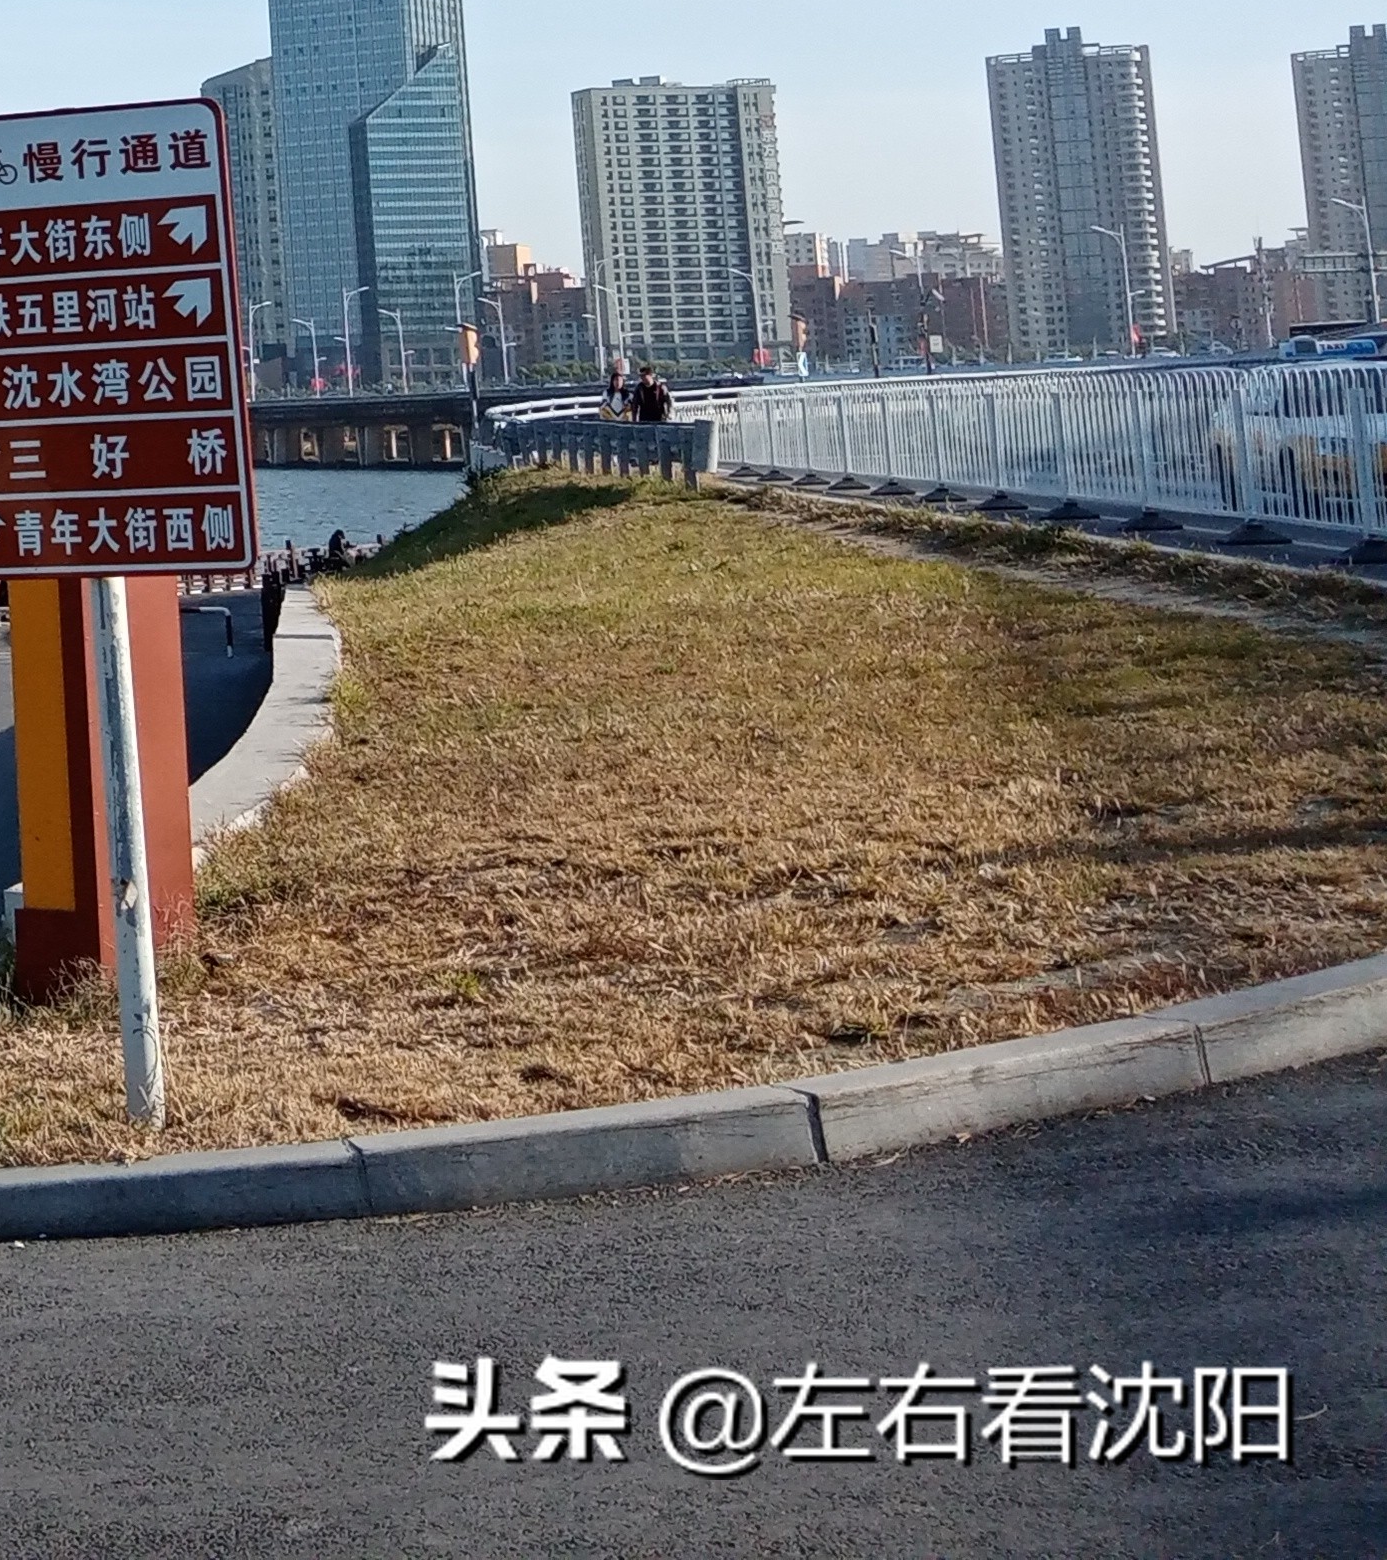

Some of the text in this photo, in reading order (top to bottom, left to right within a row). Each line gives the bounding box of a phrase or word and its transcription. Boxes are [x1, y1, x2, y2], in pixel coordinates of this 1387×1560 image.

[23, 129, 211, 184] 慢行通道
[1319, 343, 1345, 351] TAXI
[2, 355, 223, 410] 沈水湾公园
[13, 503, 235, 556] 青年大街西侧
